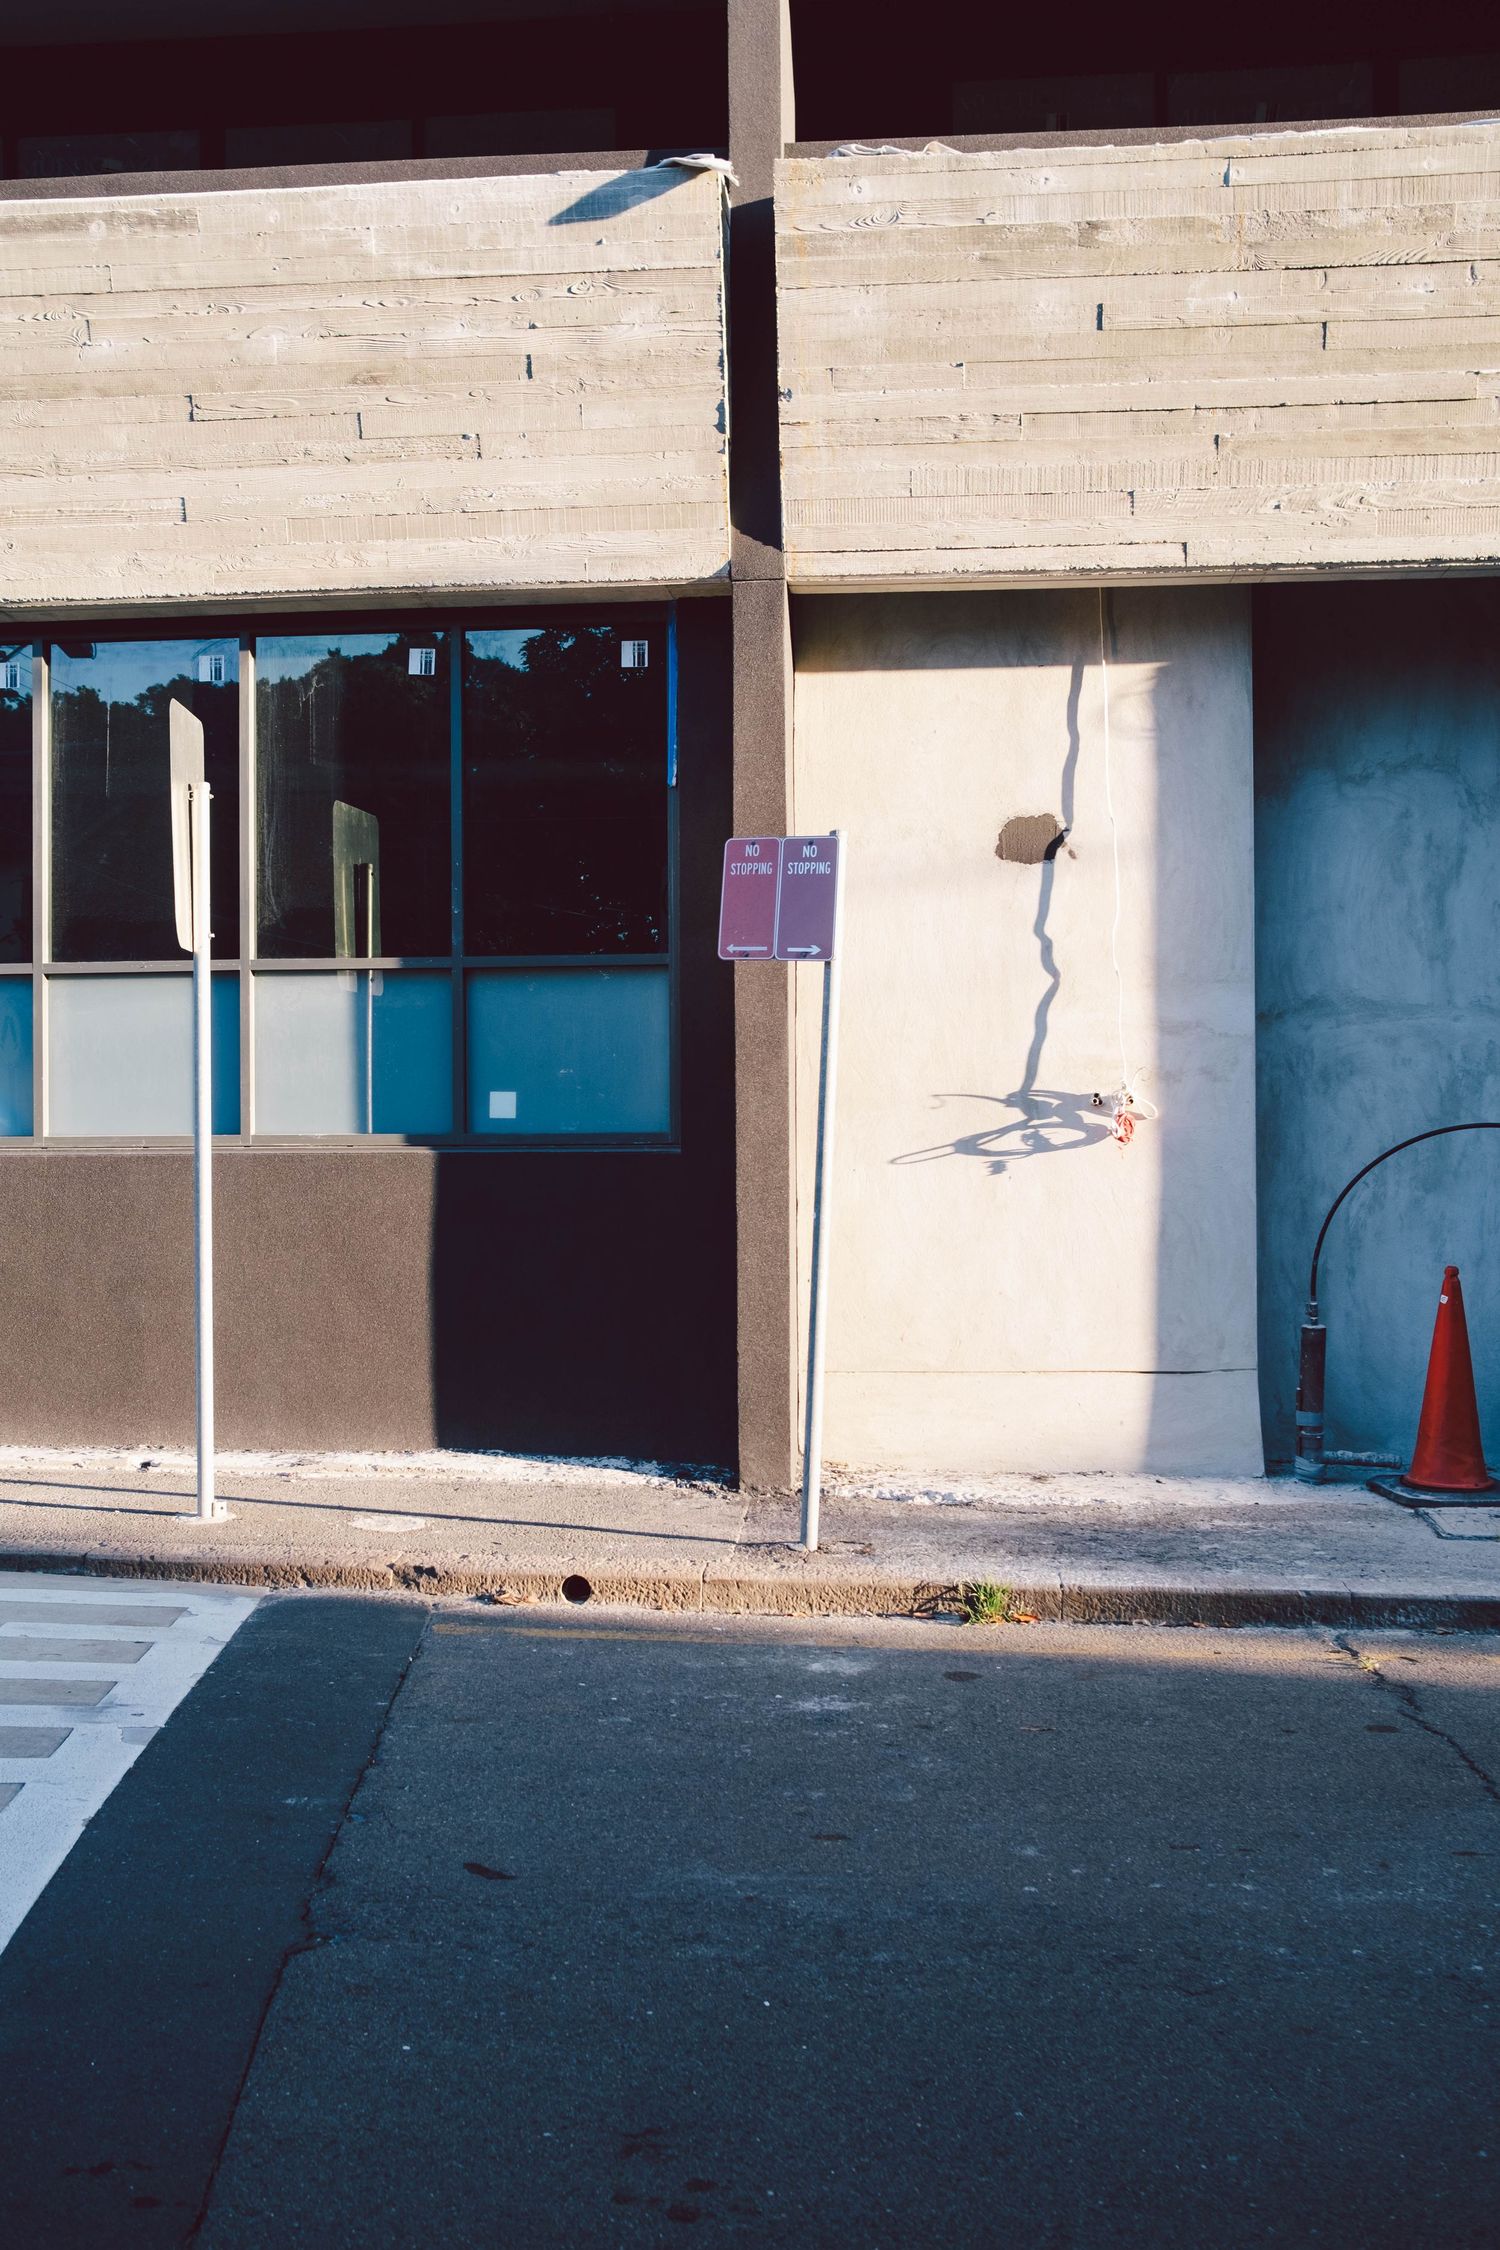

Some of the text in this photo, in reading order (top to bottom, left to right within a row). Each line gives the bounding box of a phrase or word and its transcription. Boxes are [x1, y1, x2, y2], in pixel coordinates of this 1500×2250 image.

[745, 844, 760, 857] NO
[802, 845, 818, 858] NO
[730, 862, 773, 875] STOPPING
[787, 862, 831, 875] STOPPING
